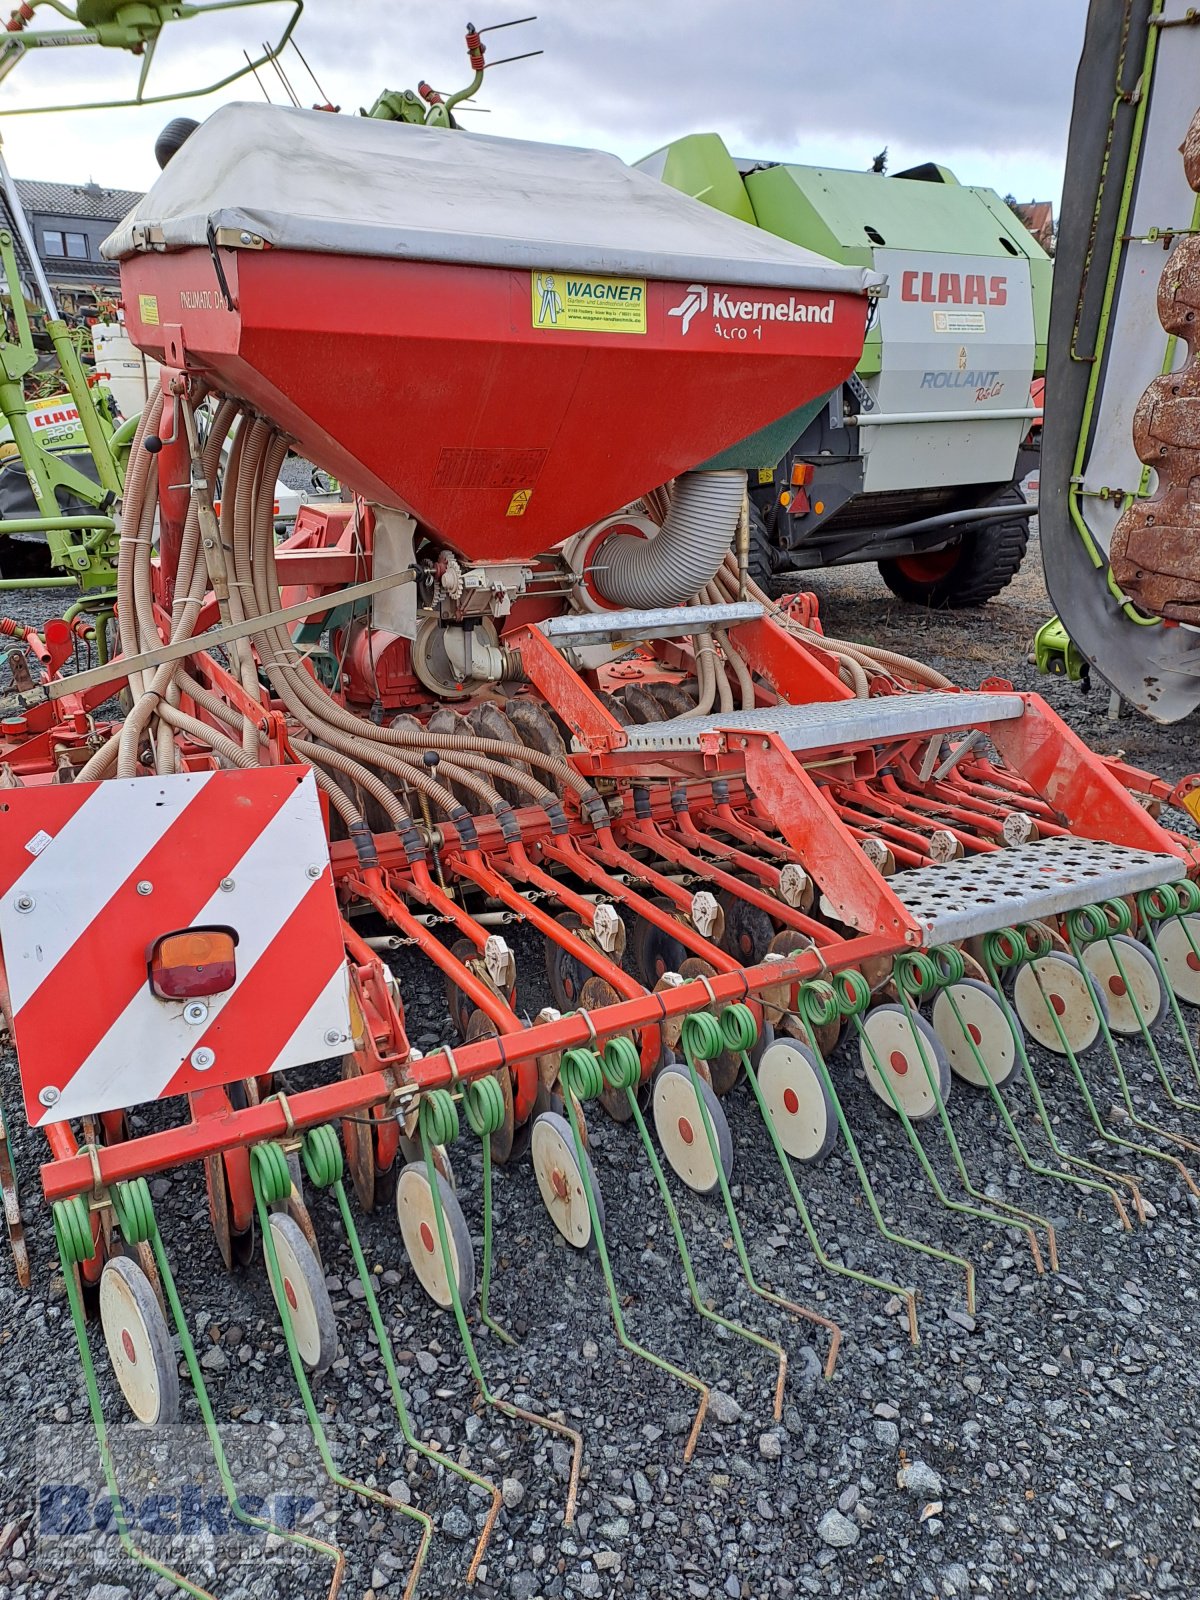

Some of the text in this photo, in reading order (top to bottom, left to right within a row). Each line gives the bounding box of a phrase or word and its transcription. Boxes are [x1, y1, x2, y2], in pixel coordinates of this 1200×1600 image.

[566, 281, 643, 301] WAGNER
[901, 270, 1007, 306] CLAAS
[180, 290, 213, 310] PNEUMATIC
[712, 292, 835, 324] Kverneland
[920, 371, 1000, 389] ROLLANT
[34, 408, 80, 428] CLAA
[42, 432, 74, 446] DISCO
